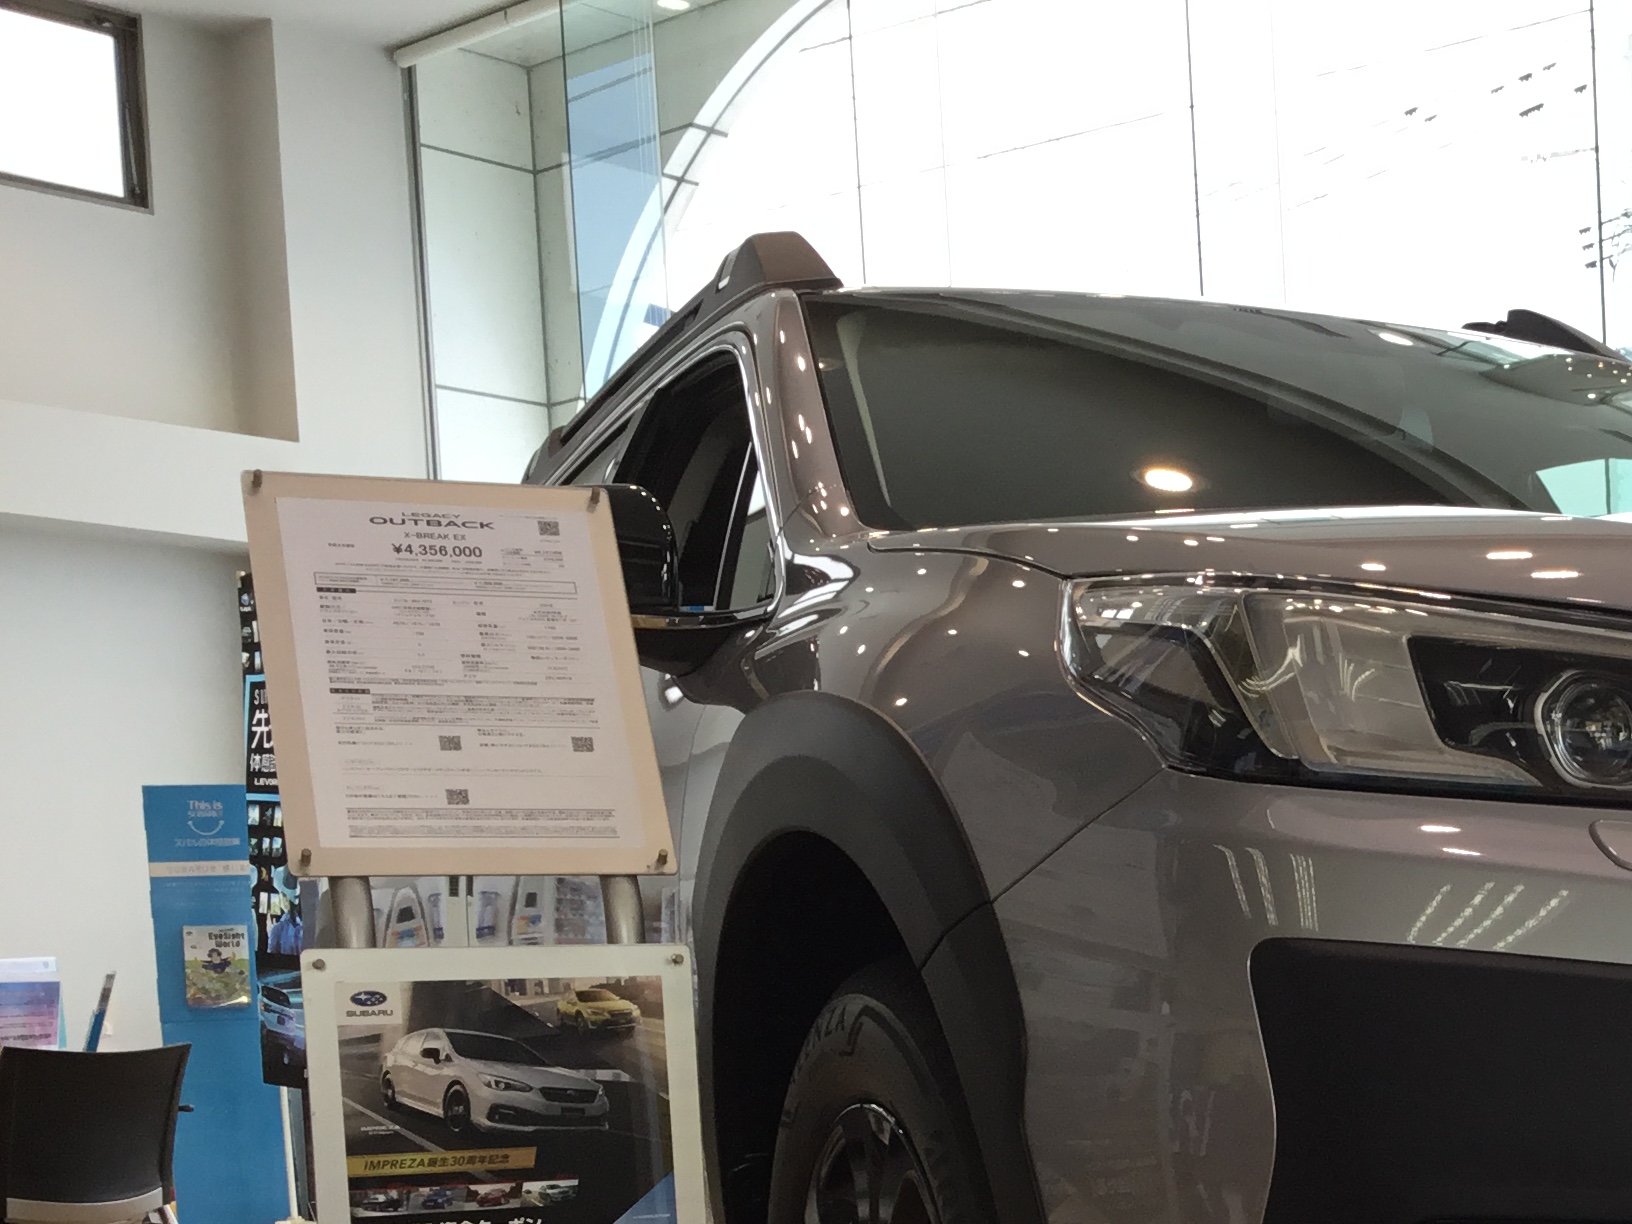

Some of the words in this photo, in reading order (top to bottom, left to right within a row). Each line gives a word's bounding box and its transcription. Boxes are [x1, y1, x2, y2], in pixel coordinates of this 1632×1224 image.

[369, 516, 495, 530] OUTBACK
[404, 531, 450, 541] X-BREAK
[453, 533, 467, 541] EX
[391, 543, 482, 558] ¥4,356,000
[187, 801, 210, 810] This
[213, 801, 223, 810] is
[346, 1009, 393, 1018] SUBARU
